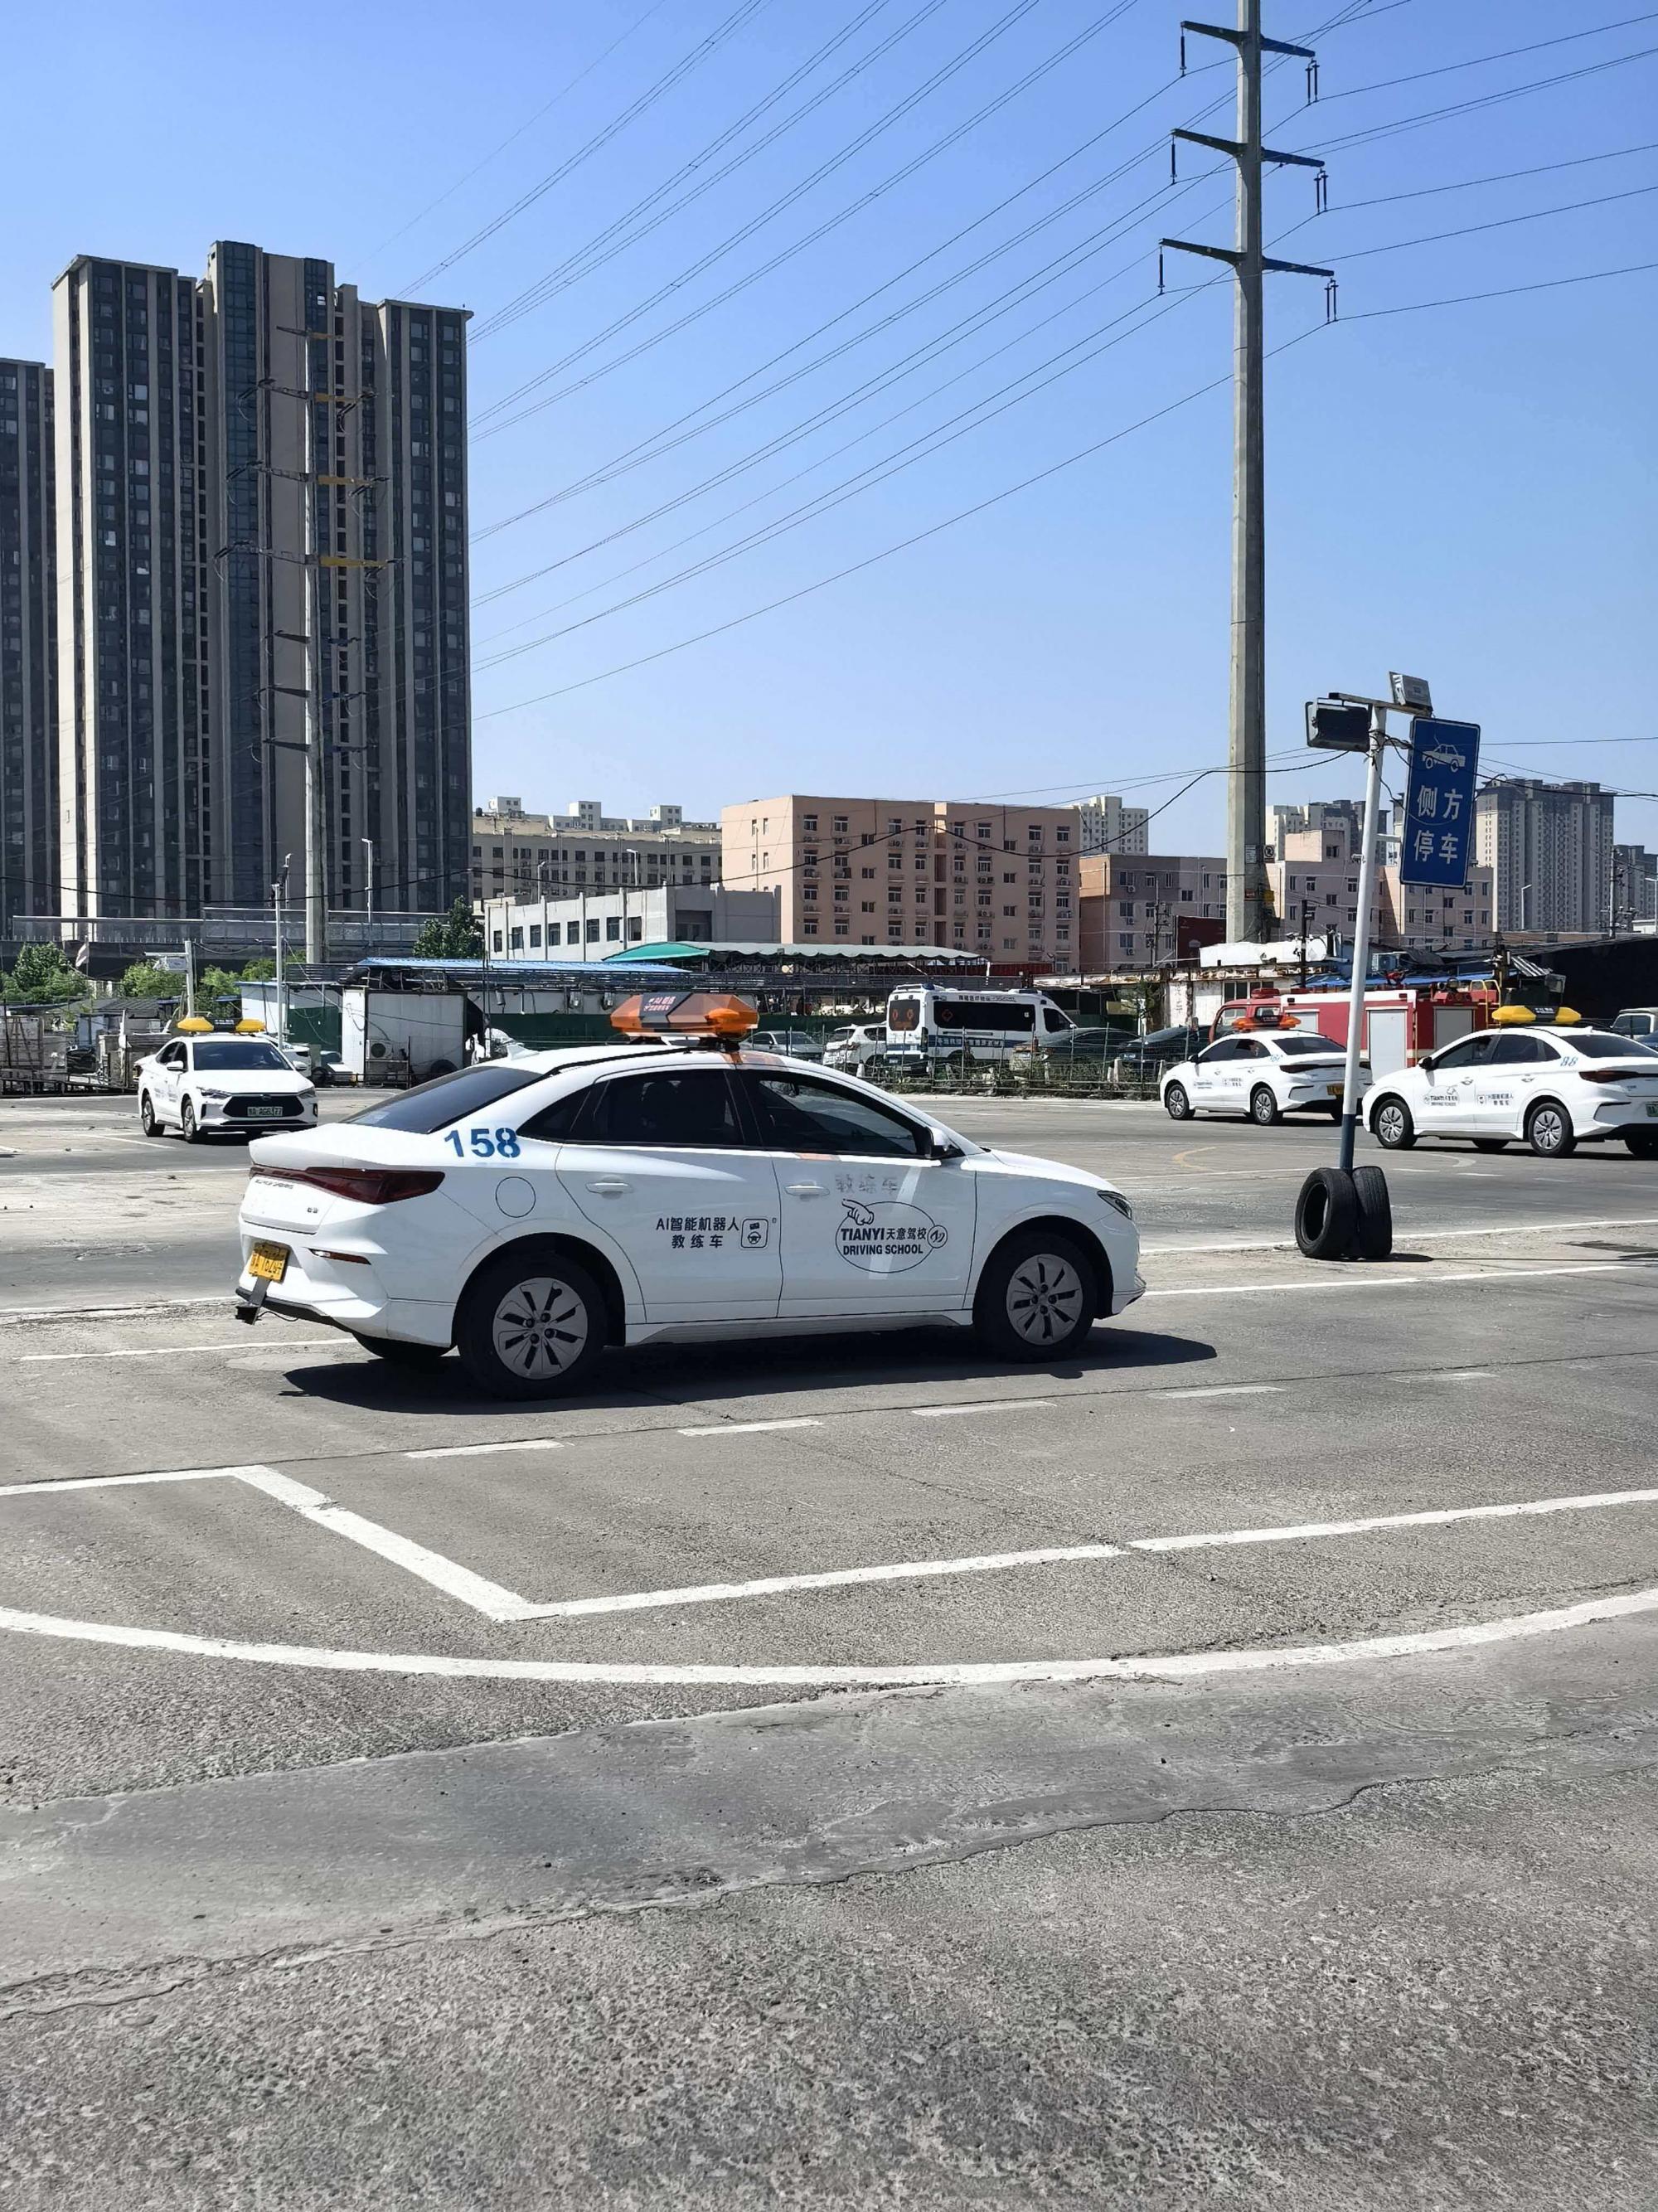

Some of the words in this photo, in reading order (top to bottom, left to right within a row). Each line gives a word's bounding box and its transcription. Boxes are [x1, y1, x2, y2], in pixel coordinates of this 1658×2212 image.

[1417, 785, 1463, 820] 侧方
[1413, 830, 1459, 865] 停车
[444, 1128, 521, 1158] 158
[656, 1216, 739, 1231] AI智能机器人
[671, 1234, 724, 1249] 教练车
[841, 1228, 885, 1241] TIANYI
[886, 1227, 927, 1240] 天意驾校
[843, 1244, 883, 1255] DRIVING
[885, 1244, 924, 1254] SCHOOL
